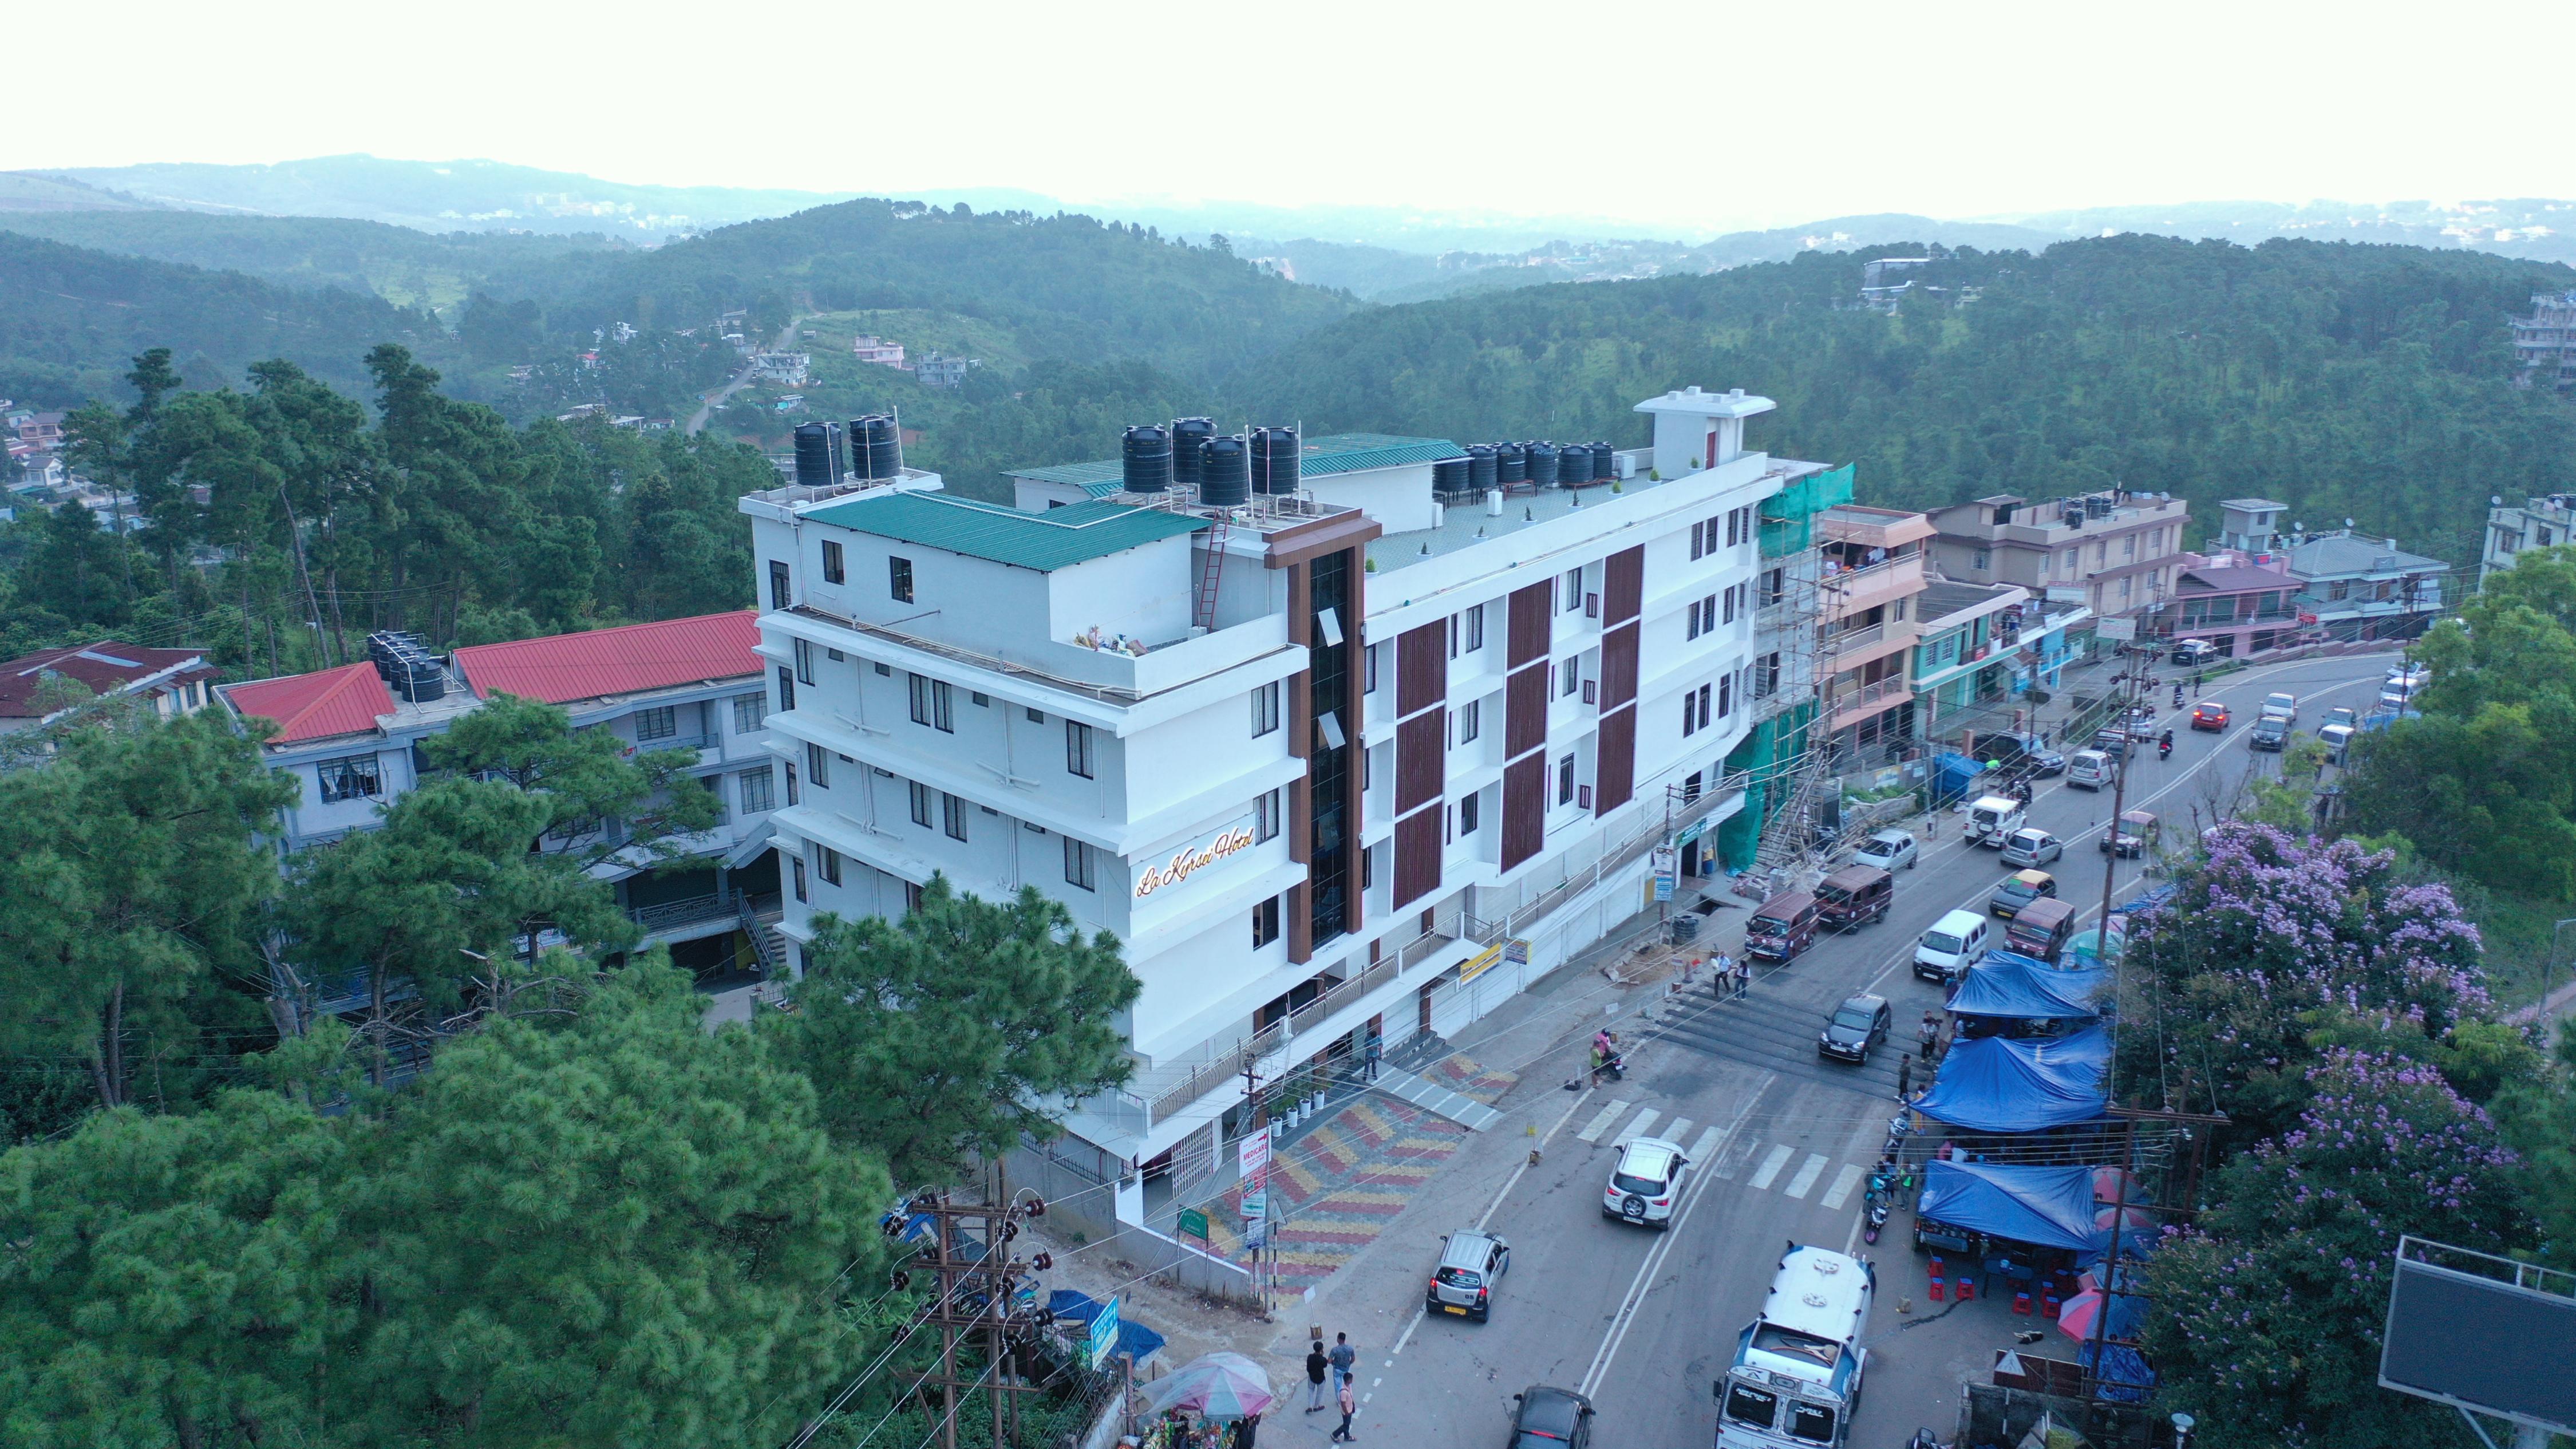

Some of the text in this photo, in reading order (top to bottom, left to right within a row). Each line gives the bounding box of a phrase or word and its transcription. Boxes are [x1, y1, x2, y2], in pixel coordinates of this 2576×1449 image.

[1137, 828, 1254, 897] La Kyrsei Hotel
[1243, 1143, 1267, 1161] MEDICARE
